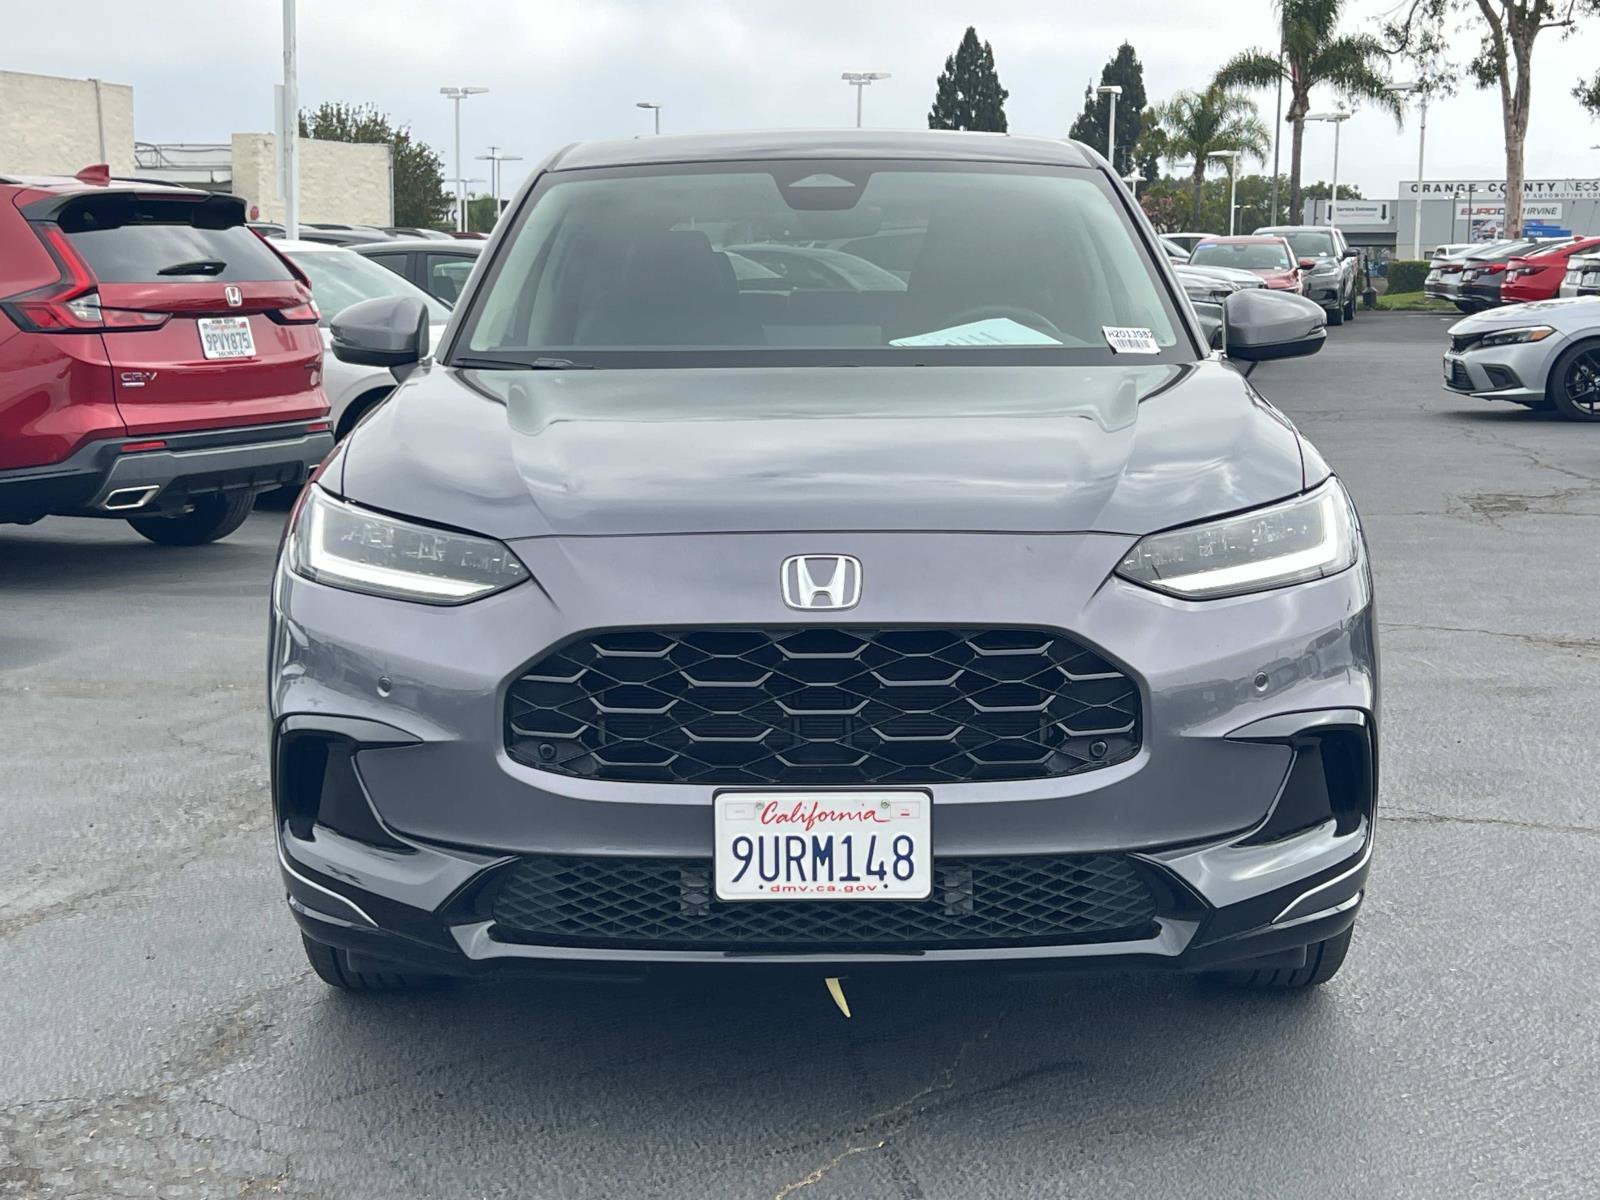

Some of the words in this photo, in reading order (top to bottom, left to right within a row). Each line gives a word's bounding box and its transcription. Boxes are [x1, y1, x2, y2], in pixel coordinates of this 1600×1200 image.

[1410, 183, 1477, 193] ORANGE
[1488, 182, 1556, 192] CONTY
[1526, 207, 1558, 215] IRVINE
[206, 332, 251, 351] 9PVY875
[760, 800, 891, 832] California
[731, 834, 915, 883] 9URM148
[769, 883, 878, 894] dmv.ca.gov
